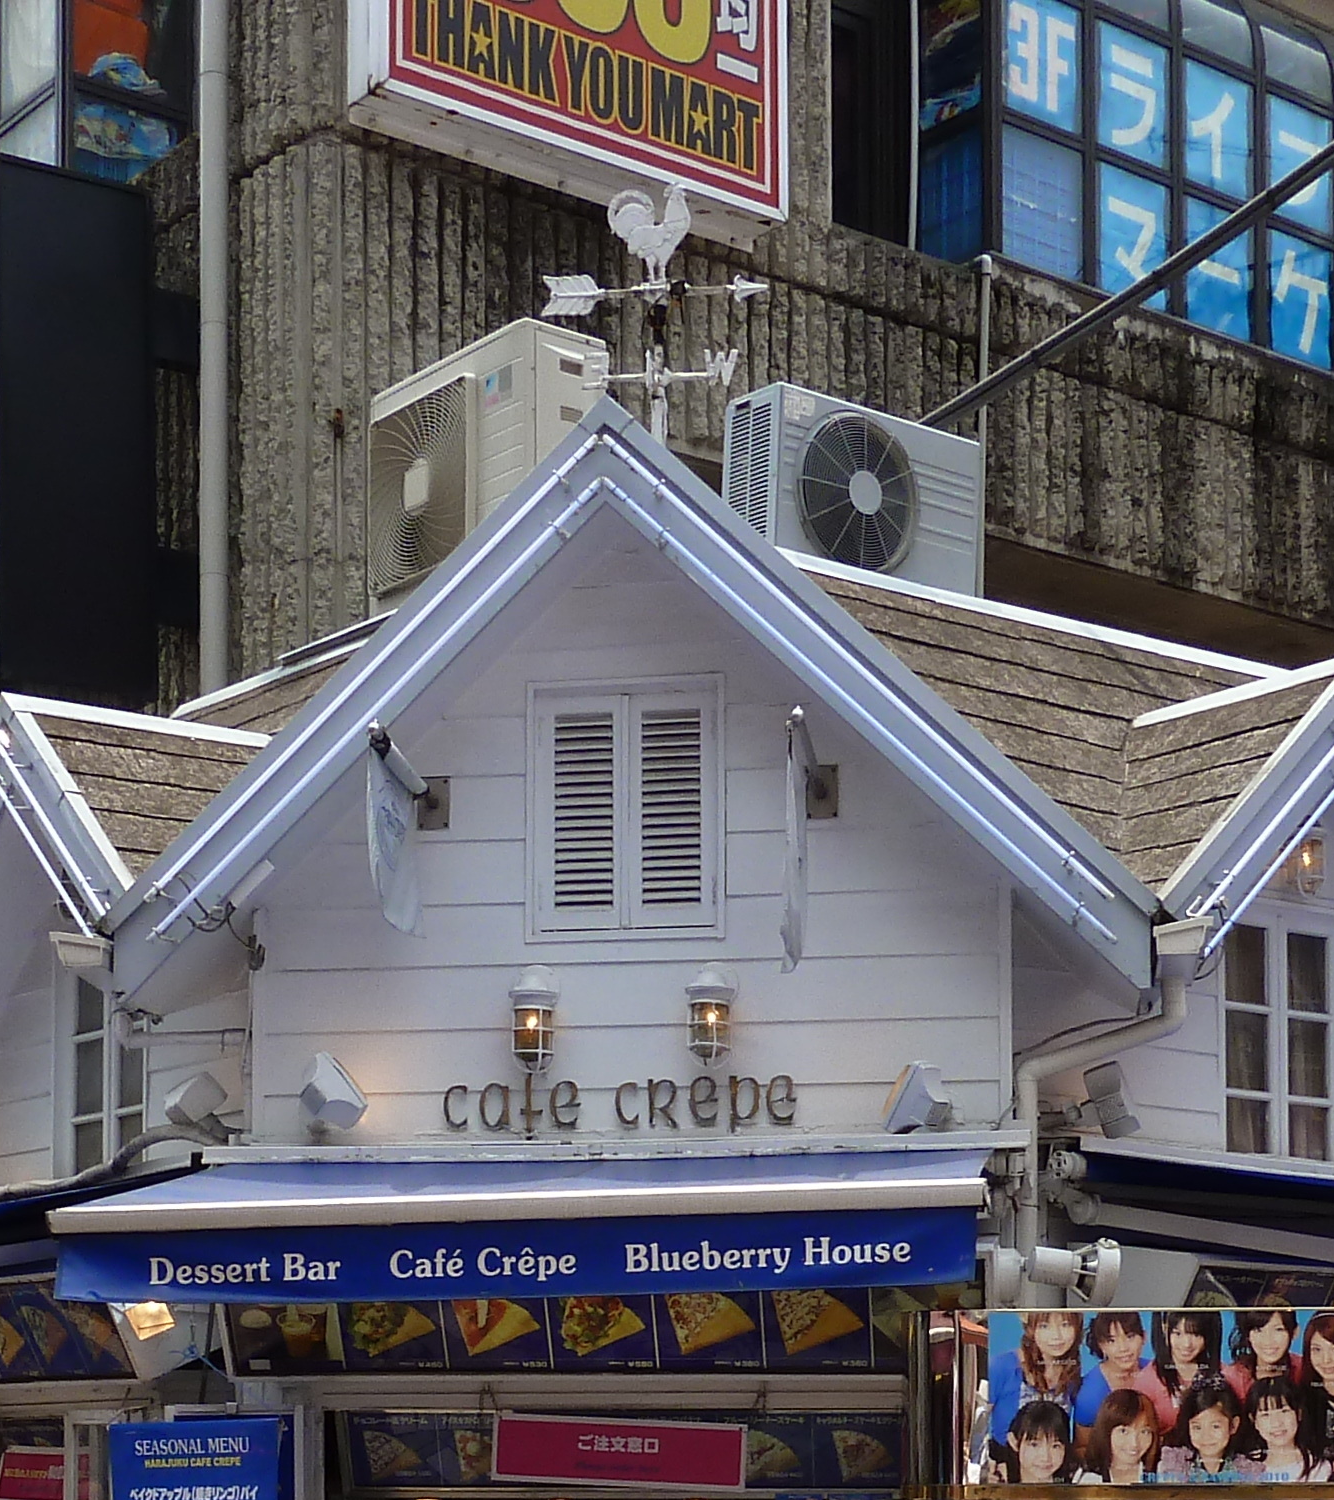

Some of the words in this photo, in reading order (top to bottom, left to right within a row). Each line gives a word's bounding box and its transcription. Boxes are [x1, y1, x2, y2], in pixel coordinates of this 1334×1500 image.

[1007, 1, 1076, 112] 3F
[411, 0, 560, 106] THANK
[562, 34, 646, 133] YOU
[648, 68, 763, 177] MART
[149, 1256, 271, 1287] Dessert
[282, 1252, 341, 1282] Bar
[389, 1245, 465, 1279] Café
[476, 1246, 578, 1282] Crêpe
[624, 1239, 792, 1277] Blueberry
[803, 1235, 913, 1267] House
[134, 1438, 206, 1456] SEASONAL
[207, 1436, 250, 1453] MENU
[577, 1433, 660, 1454] ご注文窓口
